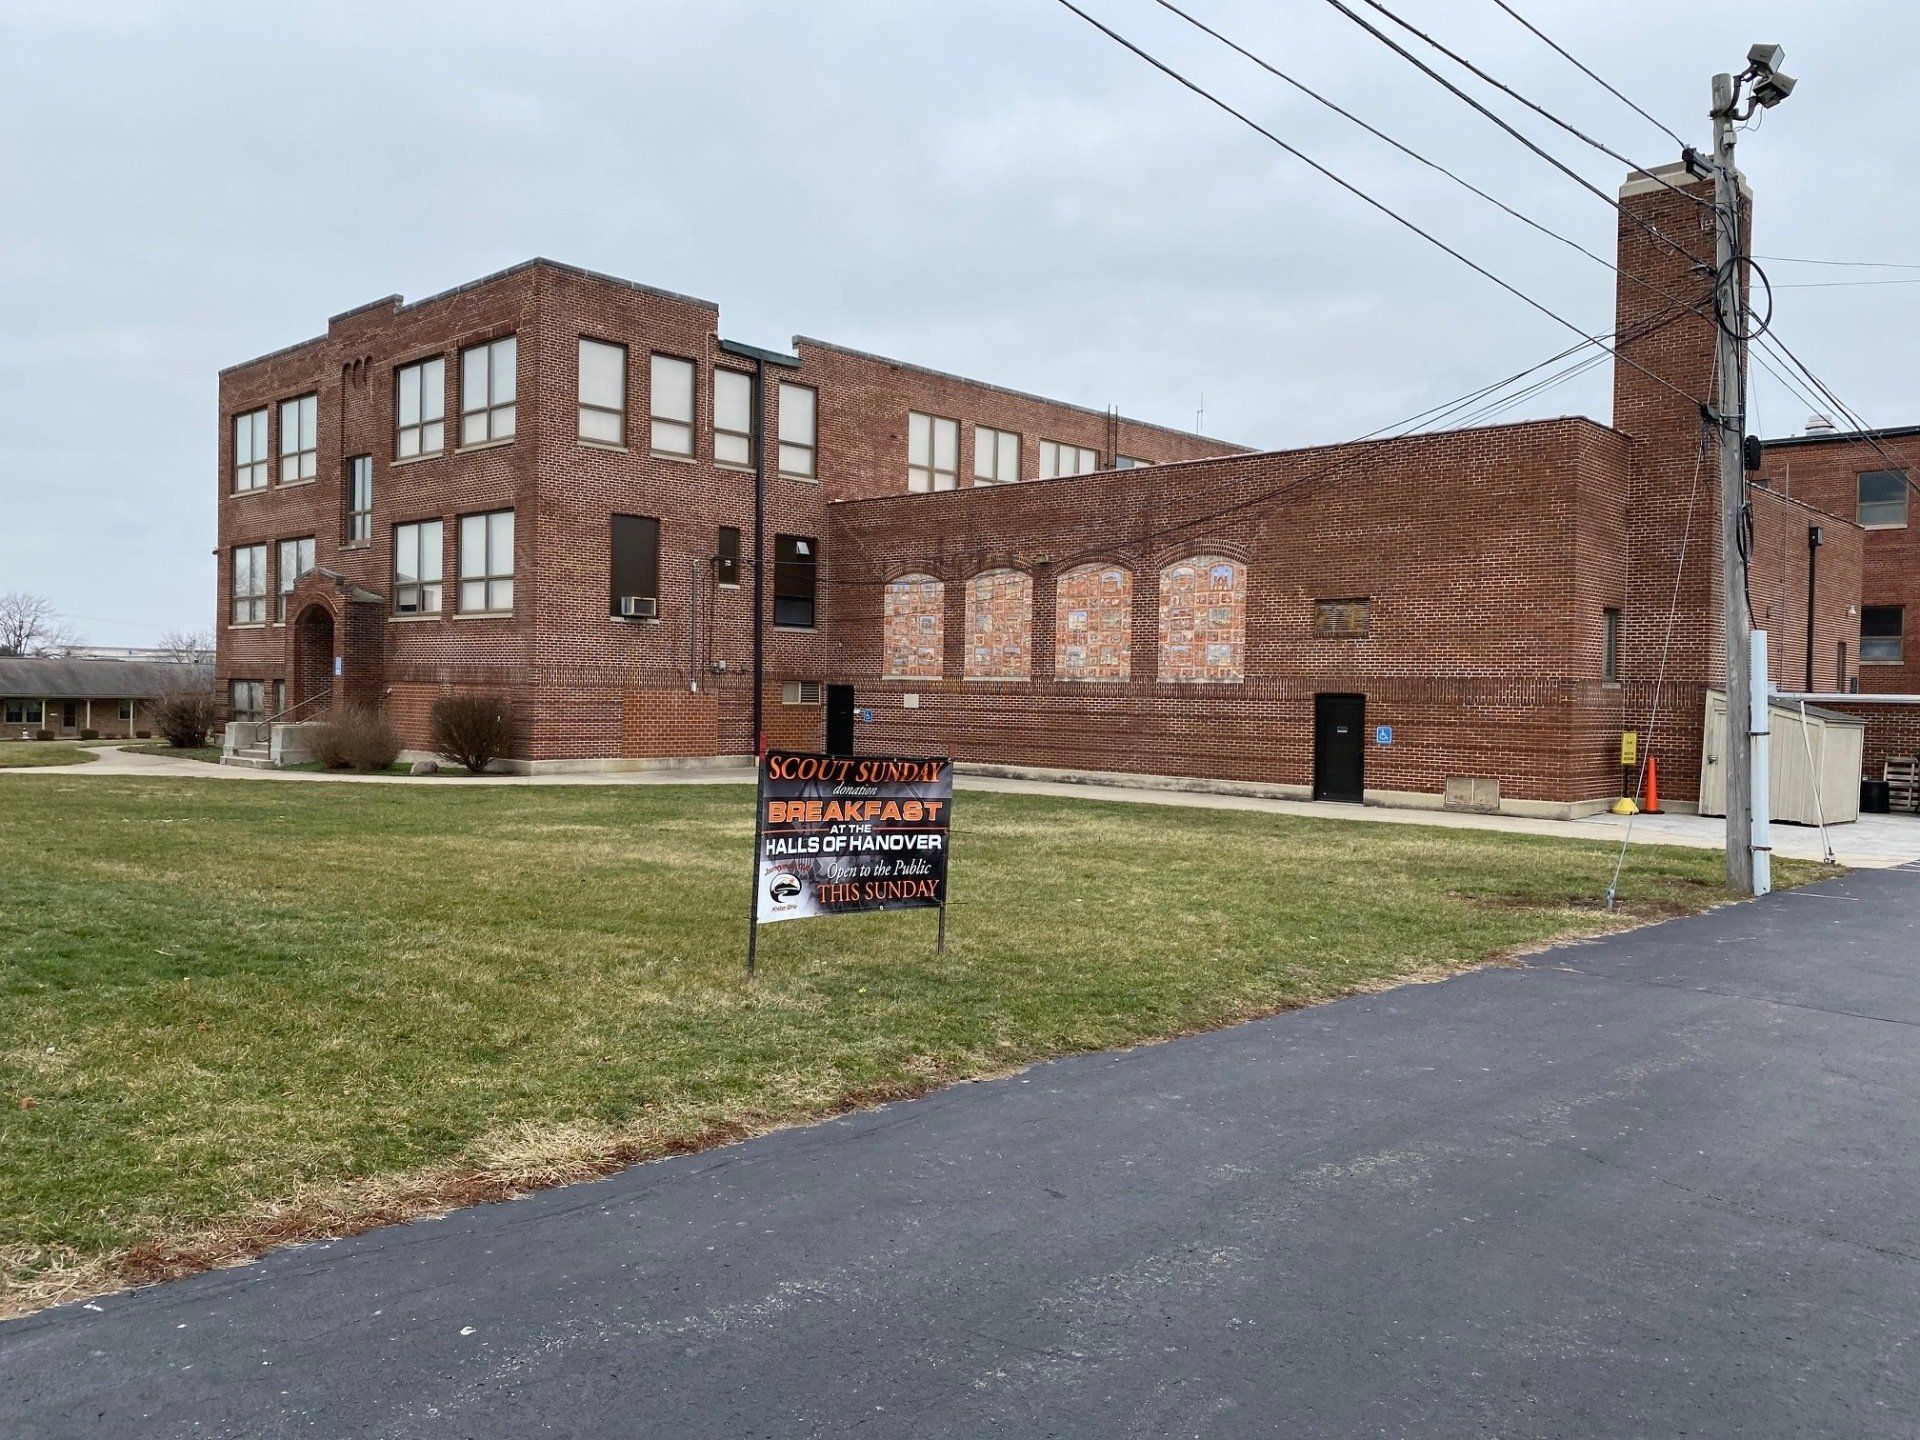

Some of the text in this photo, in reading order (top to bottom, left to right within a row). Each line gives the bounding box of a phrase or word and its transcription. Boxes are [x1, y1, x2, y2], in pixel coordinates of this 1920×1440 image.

[769, 756, 944, 783] SCOUT SUNDAY
[832, 781, 878, 796] donation
[768, 801, 943, 823] BREAKFAST
[830, 824, 872, 834] AT THE
[766, 834, 942, 856] HALLS OF HANOVER
[827, 862, 857, 883] Open
[860, 864, 870, 877] to
[873, 860, 890, 876] the
[893, 859, 932, 876] Public
[818, 880, 940, 903] THIS SUNDAY
